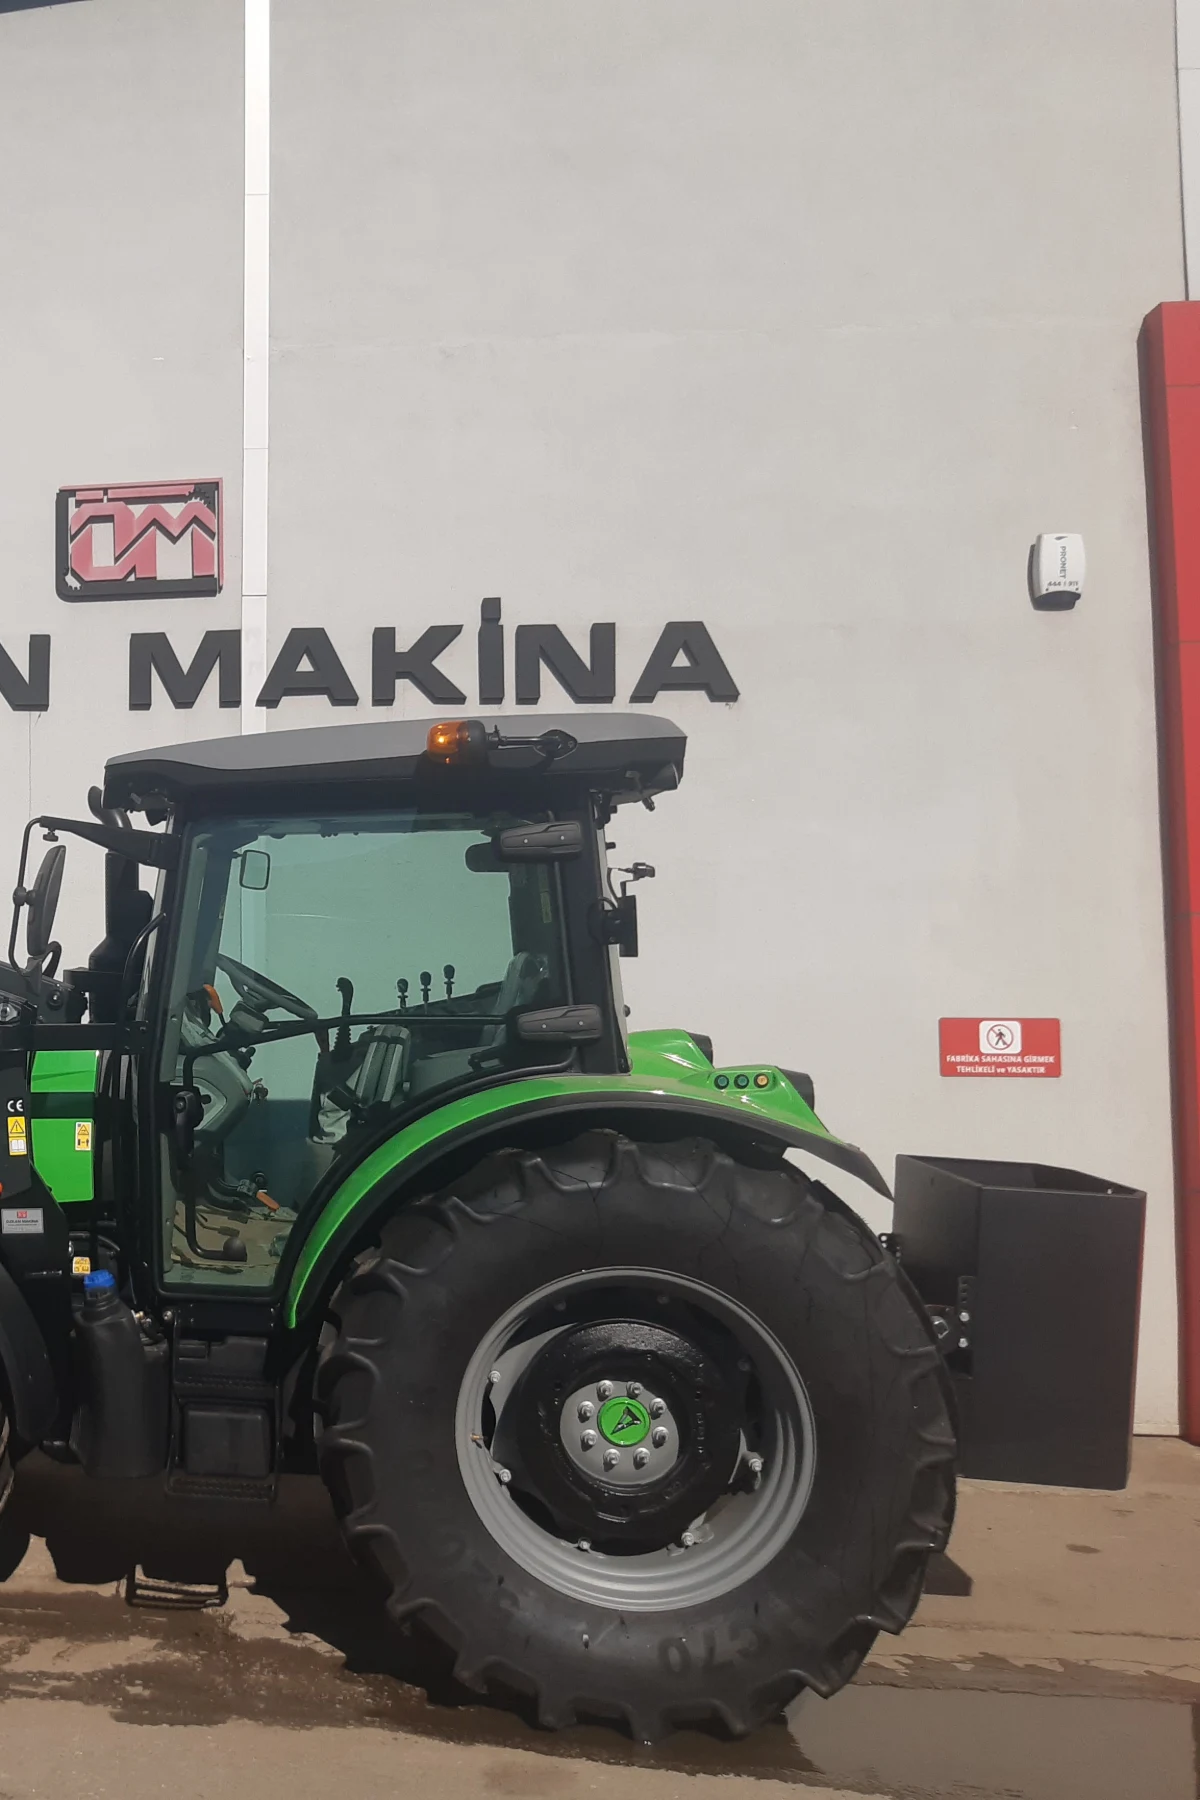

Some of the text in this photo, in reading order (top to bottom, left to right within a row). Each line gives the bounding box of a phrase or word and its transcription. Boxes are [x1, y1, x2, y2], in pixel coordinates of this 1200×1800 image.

[1059, 546, 1067, 579] PRONET
[128, 596, 741, 712] MAKİNA
[946, 1054, 1055, 1063] FABRİKA SAHASINA GİRMEK
[956, 1065, 995, 1074] TEHLİKELİ
[1007, 1066, 1046, 1074] YASAKTIR
[7, 1099, 24, 1113] CE
